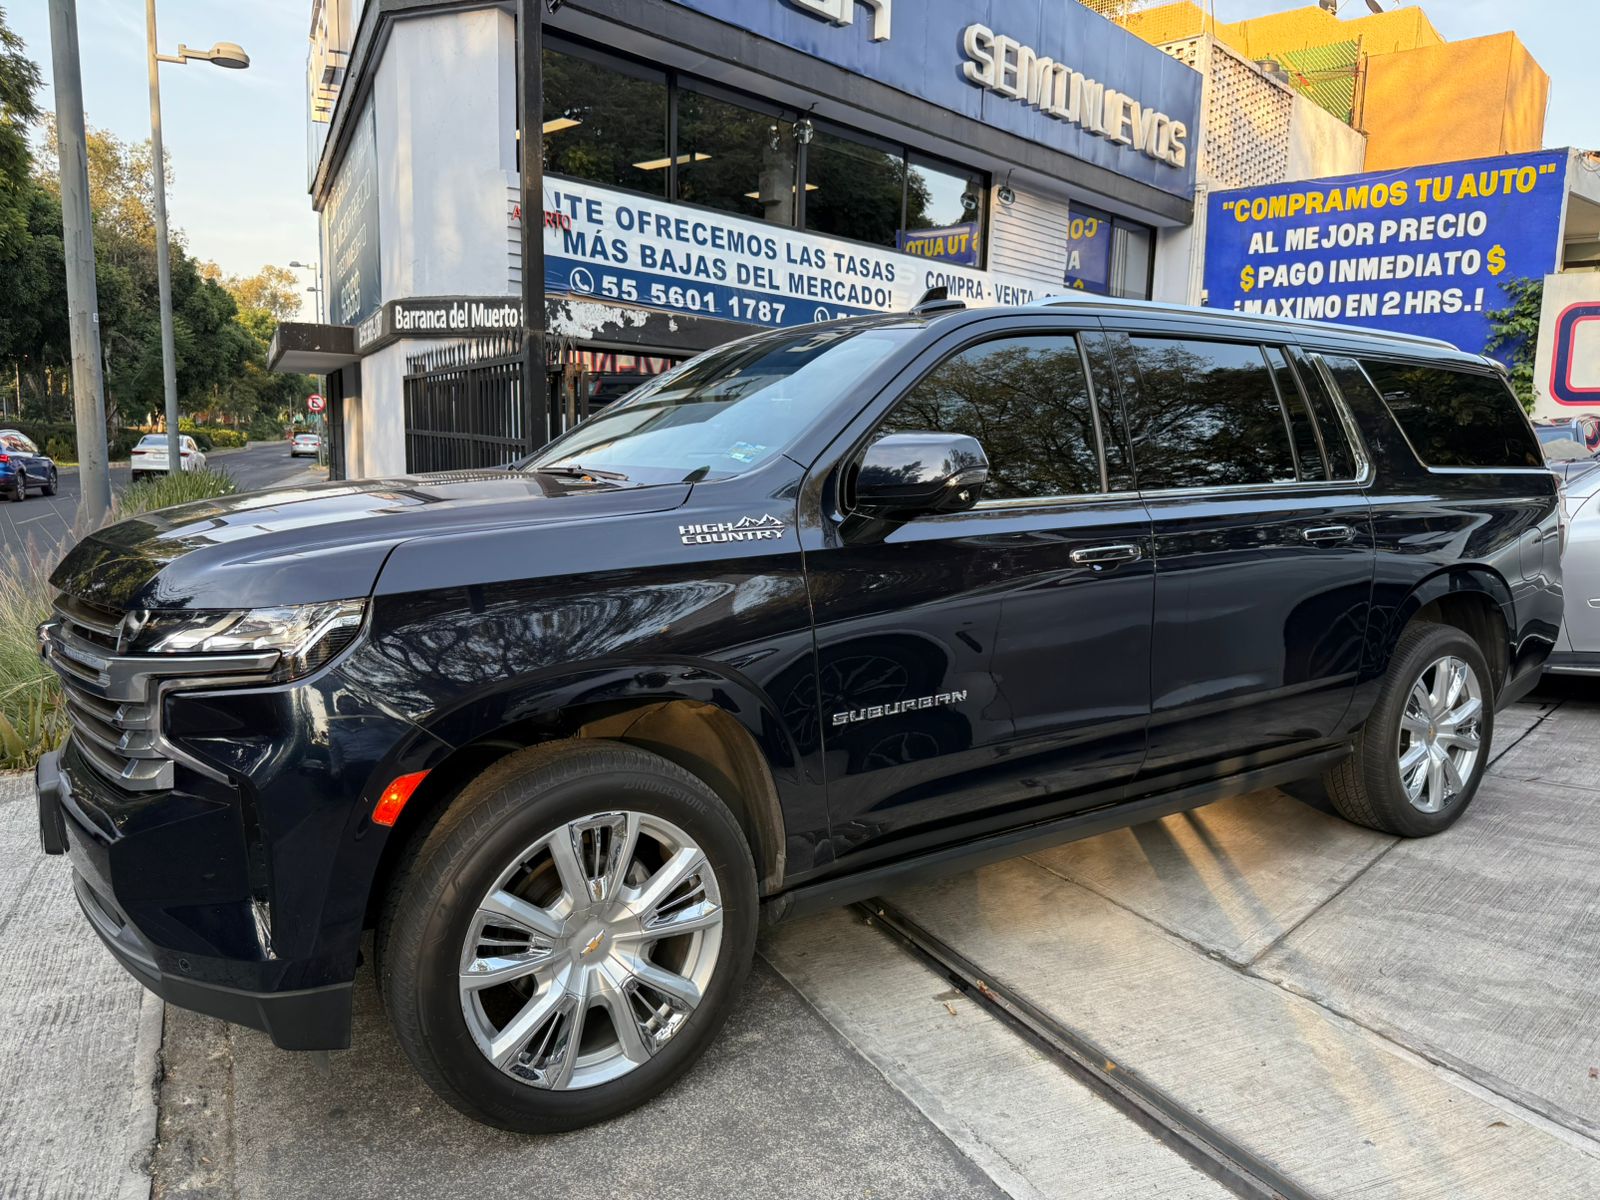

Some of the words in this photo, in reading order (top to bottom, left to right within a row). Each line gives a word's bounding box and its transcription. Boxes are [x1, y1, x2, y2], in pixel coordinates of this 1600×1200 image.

[963, 23, 1188, 168] SEMINUEVOS
[1222, 181, 1408, 223] "COMPRAMOS
[1415, 177, 1452, 203] TU
[1458, 163, 1556, 200] AUTO"
[616, 206, 777, 260] OFRECEMOS
[786, 242, 826, 270] LAS
[834, 252, 895, 282] TASAS
[1248, 232, 1279, 255] AL
[1285, 222, 1374, 252] MEJOR
[1379, 210, 1488, 245] PRECIO
[563, 229, 628, 264] MÁS
[640, 244, 727, 281] BAJAS
[736, 262, 780, 290] DEL
[789, 273, 892, 309] MERCADO!
[925, 270, 984, 300] COMPRA
[994, 283, 1034, 306] VENTA
[1258, 264, 1325, 289] PAGO
[1329, 249, 1481, 284] INMEDIATO
[395, 305, 447, 329] Barranca
[449, 302, 468, 329] del
[472, 303, 518, 328] Muerto
[601, 275, 638, 301] 55
[651, 283, 716, 312] 5601
[728, 295, 786, 324] 1787
[1345, 294, 1377, 318] EN
[1381, 294, 1401, 316] 2
[1404, 287, 1485, 315] HRS.!
[678, 522, 734, 535] HIGH
[681, 529, 785, 545] COUNTRY
[832, 690, 968, 727] SUBURBAN
